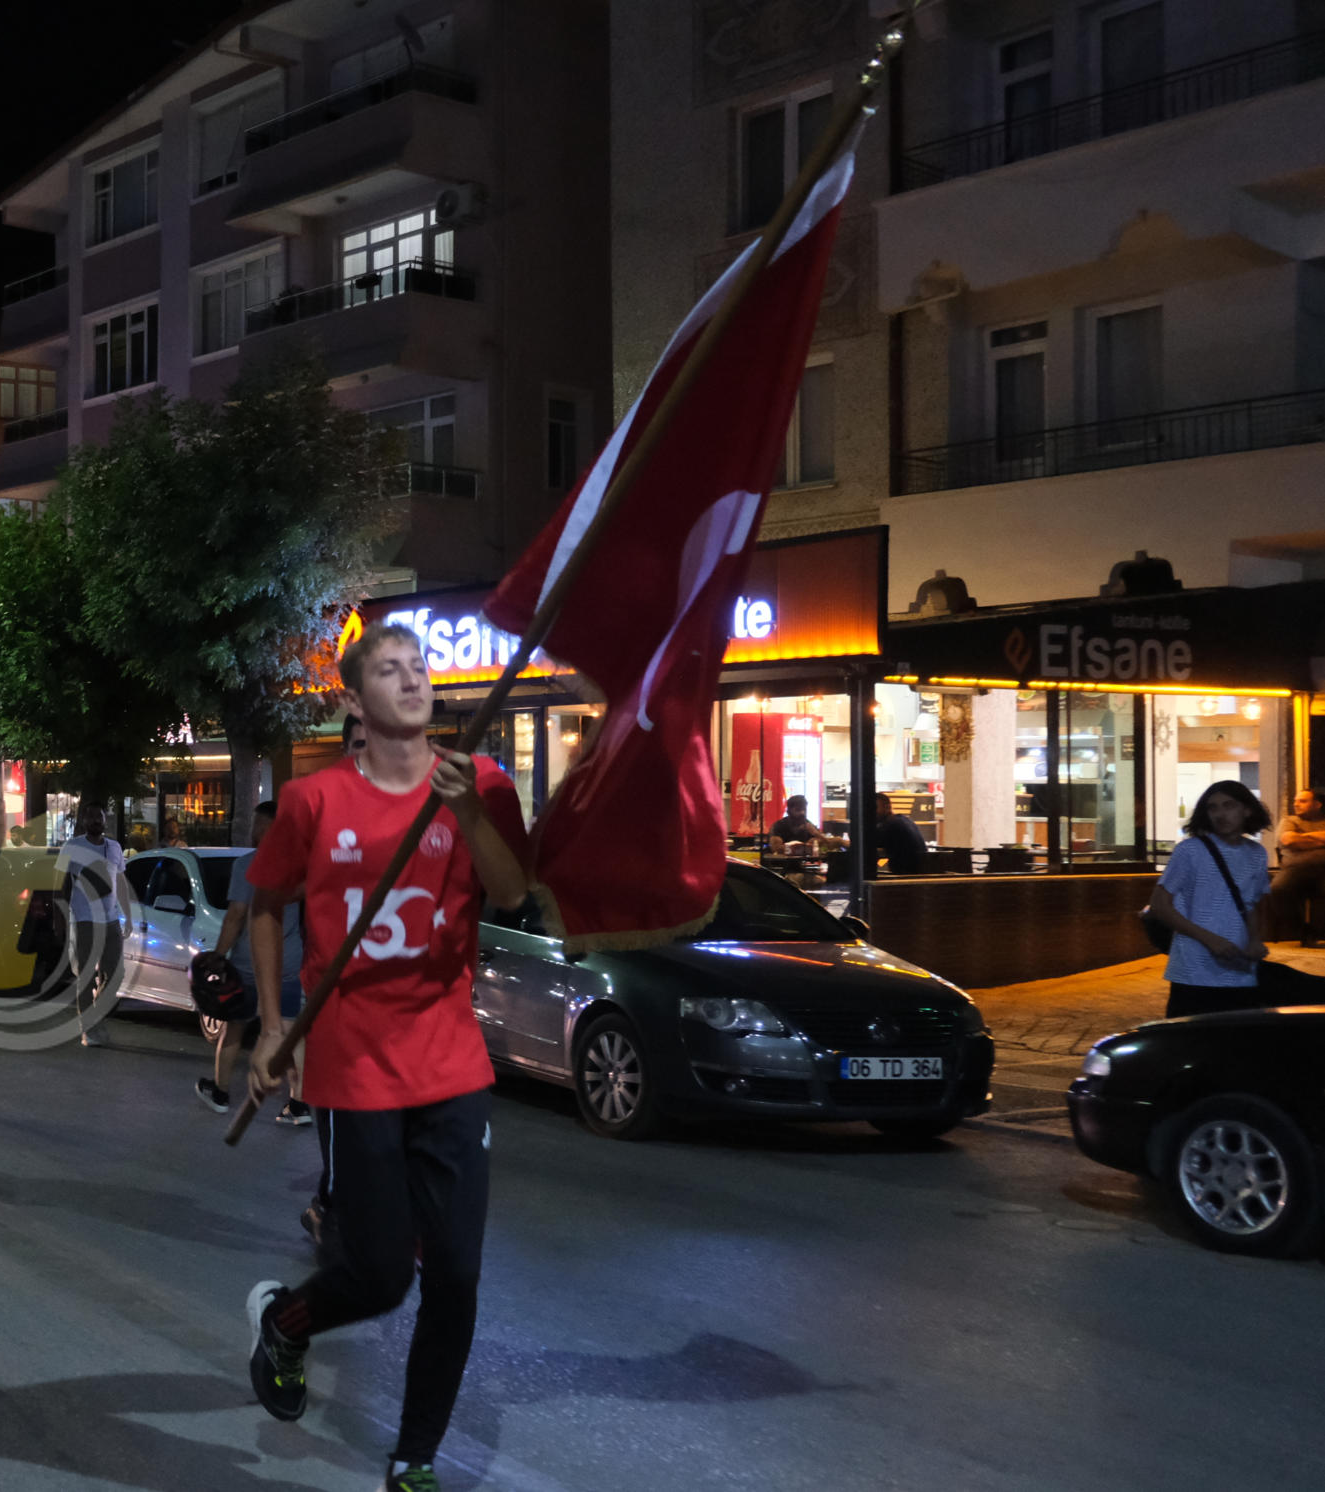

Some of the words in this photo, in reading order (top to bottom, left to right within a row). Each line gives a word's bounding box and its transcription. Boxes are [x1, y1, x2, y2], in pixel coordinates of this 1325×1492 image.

[1040, 624, 1192, 680] Efsane
[849, 1059, 871, 1078] 06
[878, 1060, 903, 1078] TD
[911, 1060, 940, 1078] 364
